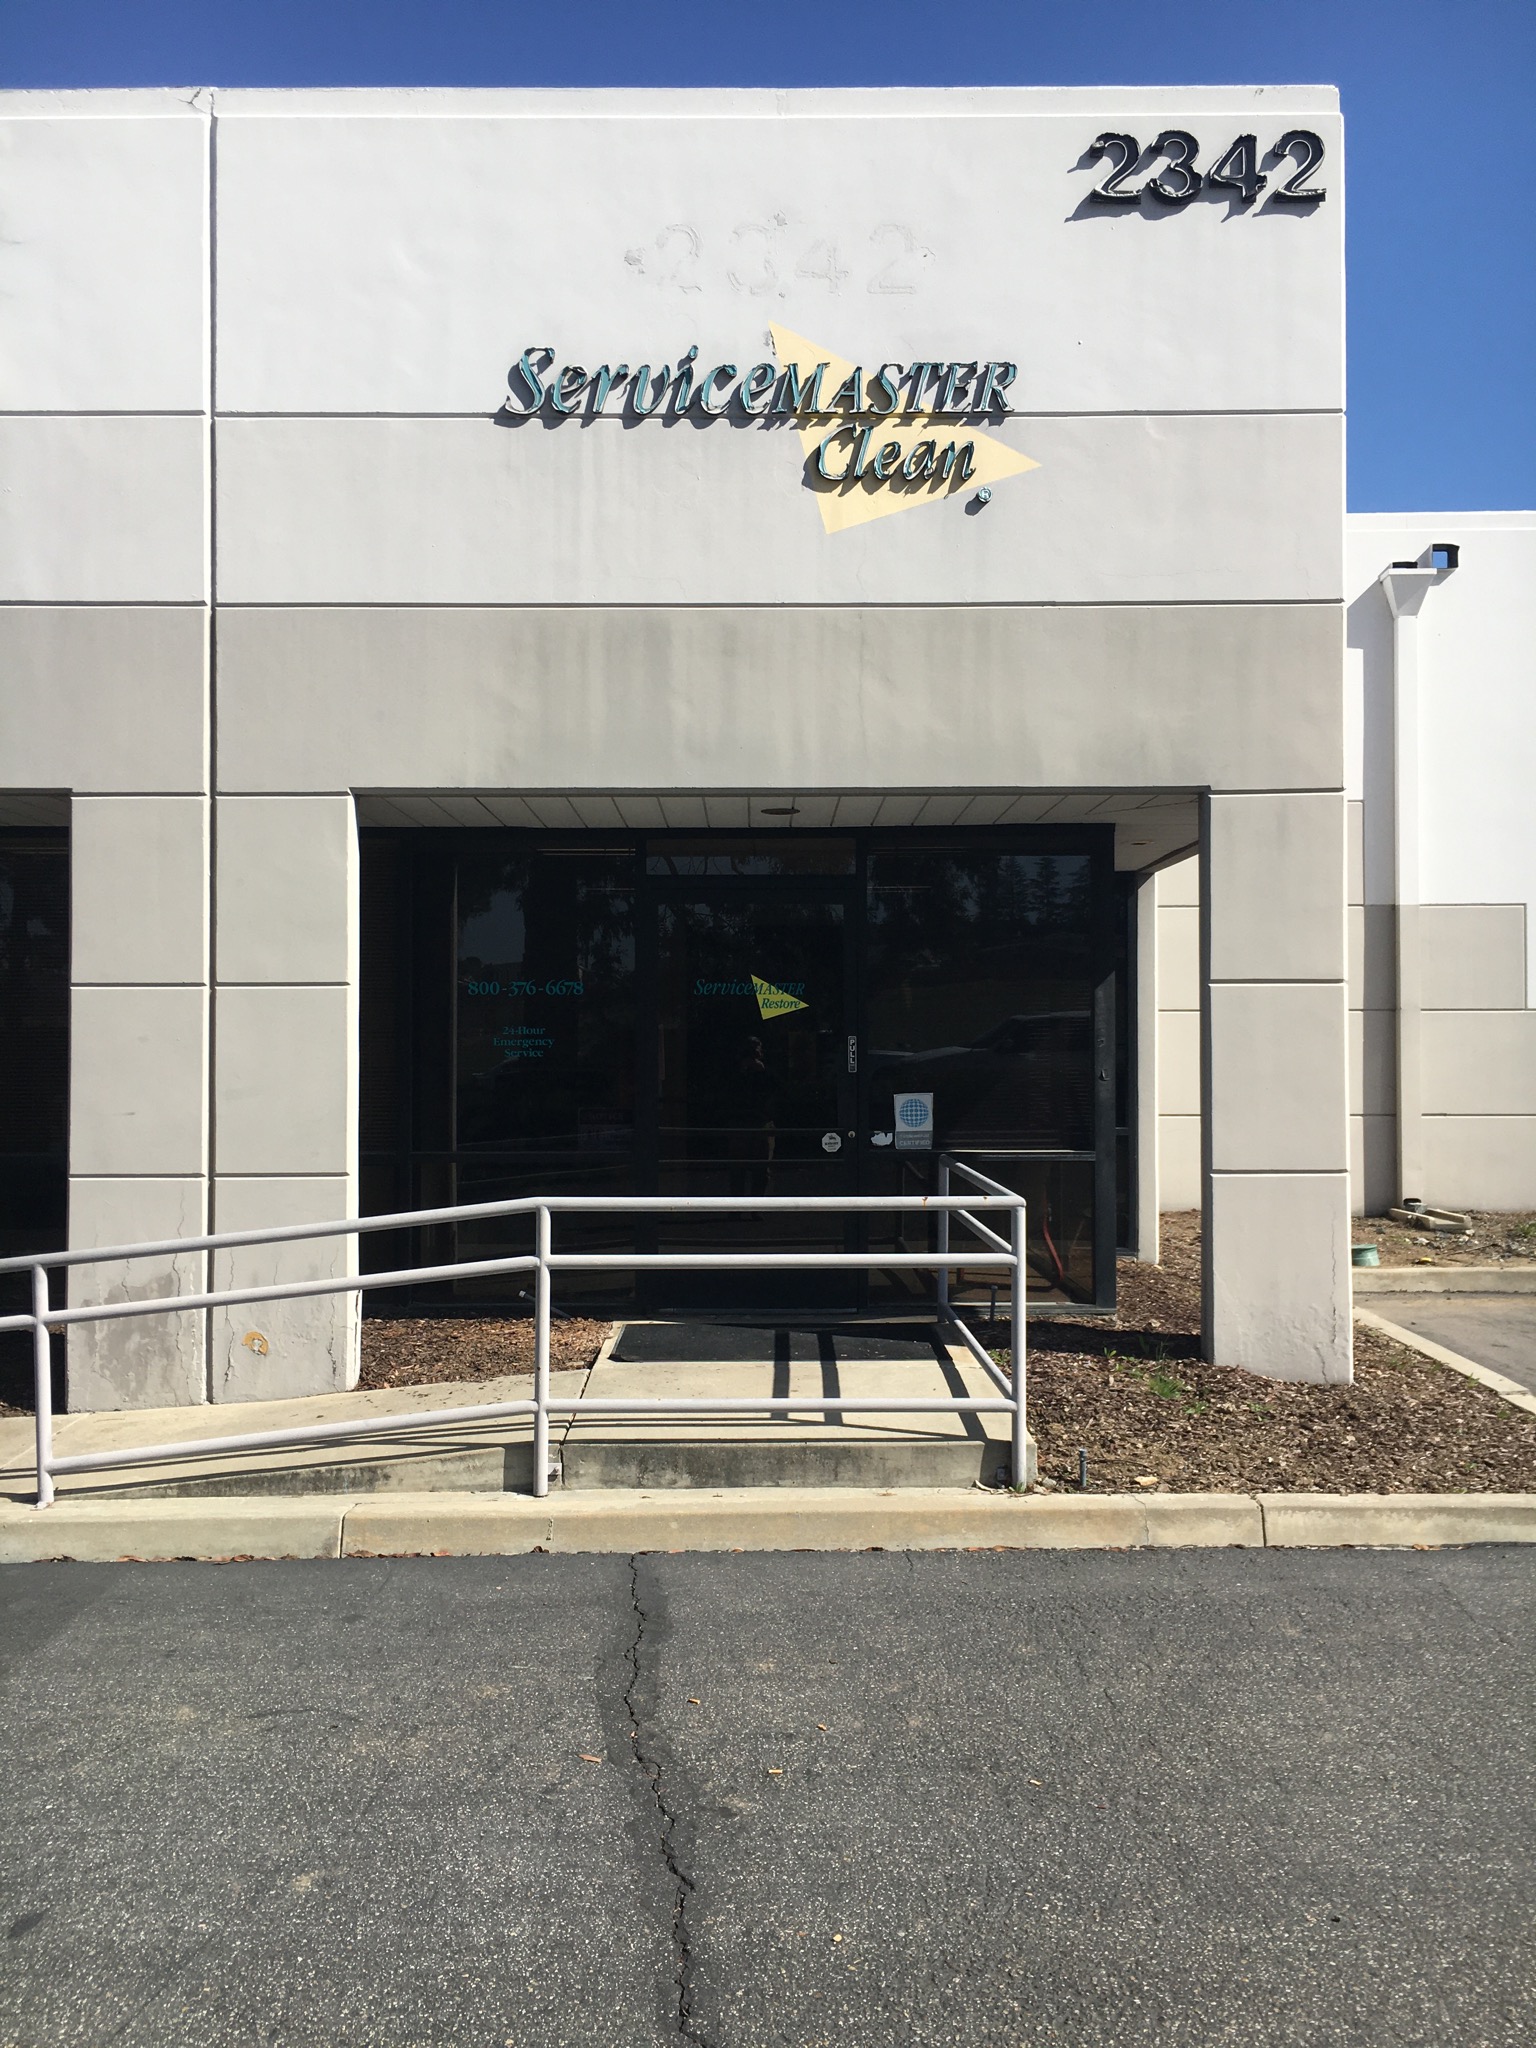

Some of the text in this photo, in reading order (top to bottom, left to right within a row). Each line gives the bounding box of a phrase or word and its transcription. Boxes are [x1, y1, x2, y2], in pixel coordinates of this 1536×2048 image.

[1089, 130, 1327, 205] 2342
[816, 423, 976, 481] Clean
[467, 979, 584, 997] 800-376-6678
[761, 998, 801, 1009] Restore
[502, 1026, 546, 1035] 24-Hour
[493, 1037, 555, 1048] Emergency
[504, 1048, 544, 1058] Service
